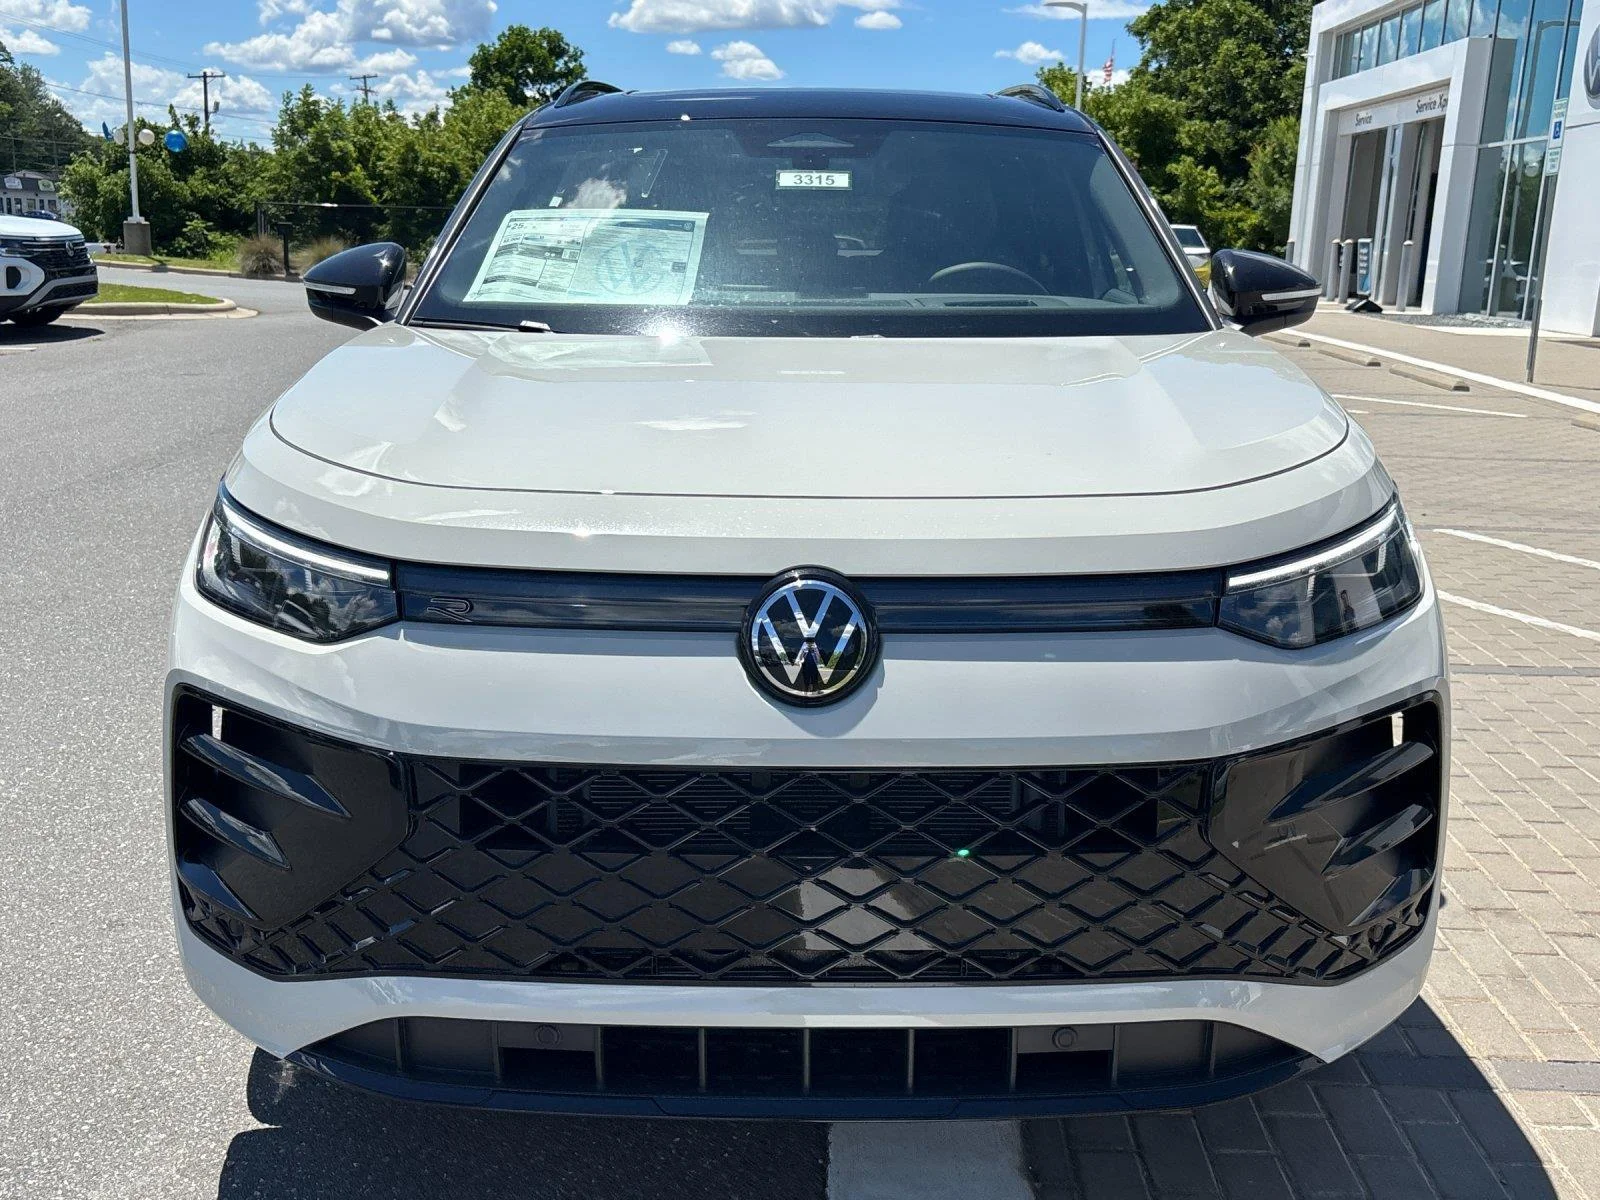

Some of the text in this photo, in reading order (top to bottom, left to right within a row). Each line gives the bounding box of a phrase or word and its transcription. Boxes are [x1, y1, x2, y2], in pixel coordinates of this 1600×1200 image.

[1416, 98, 1436, 114] Service
[1355, 113, 1372, 126] Service
[793, 174, 835, 185] 3315
[751, 580, 867, 697] VW
